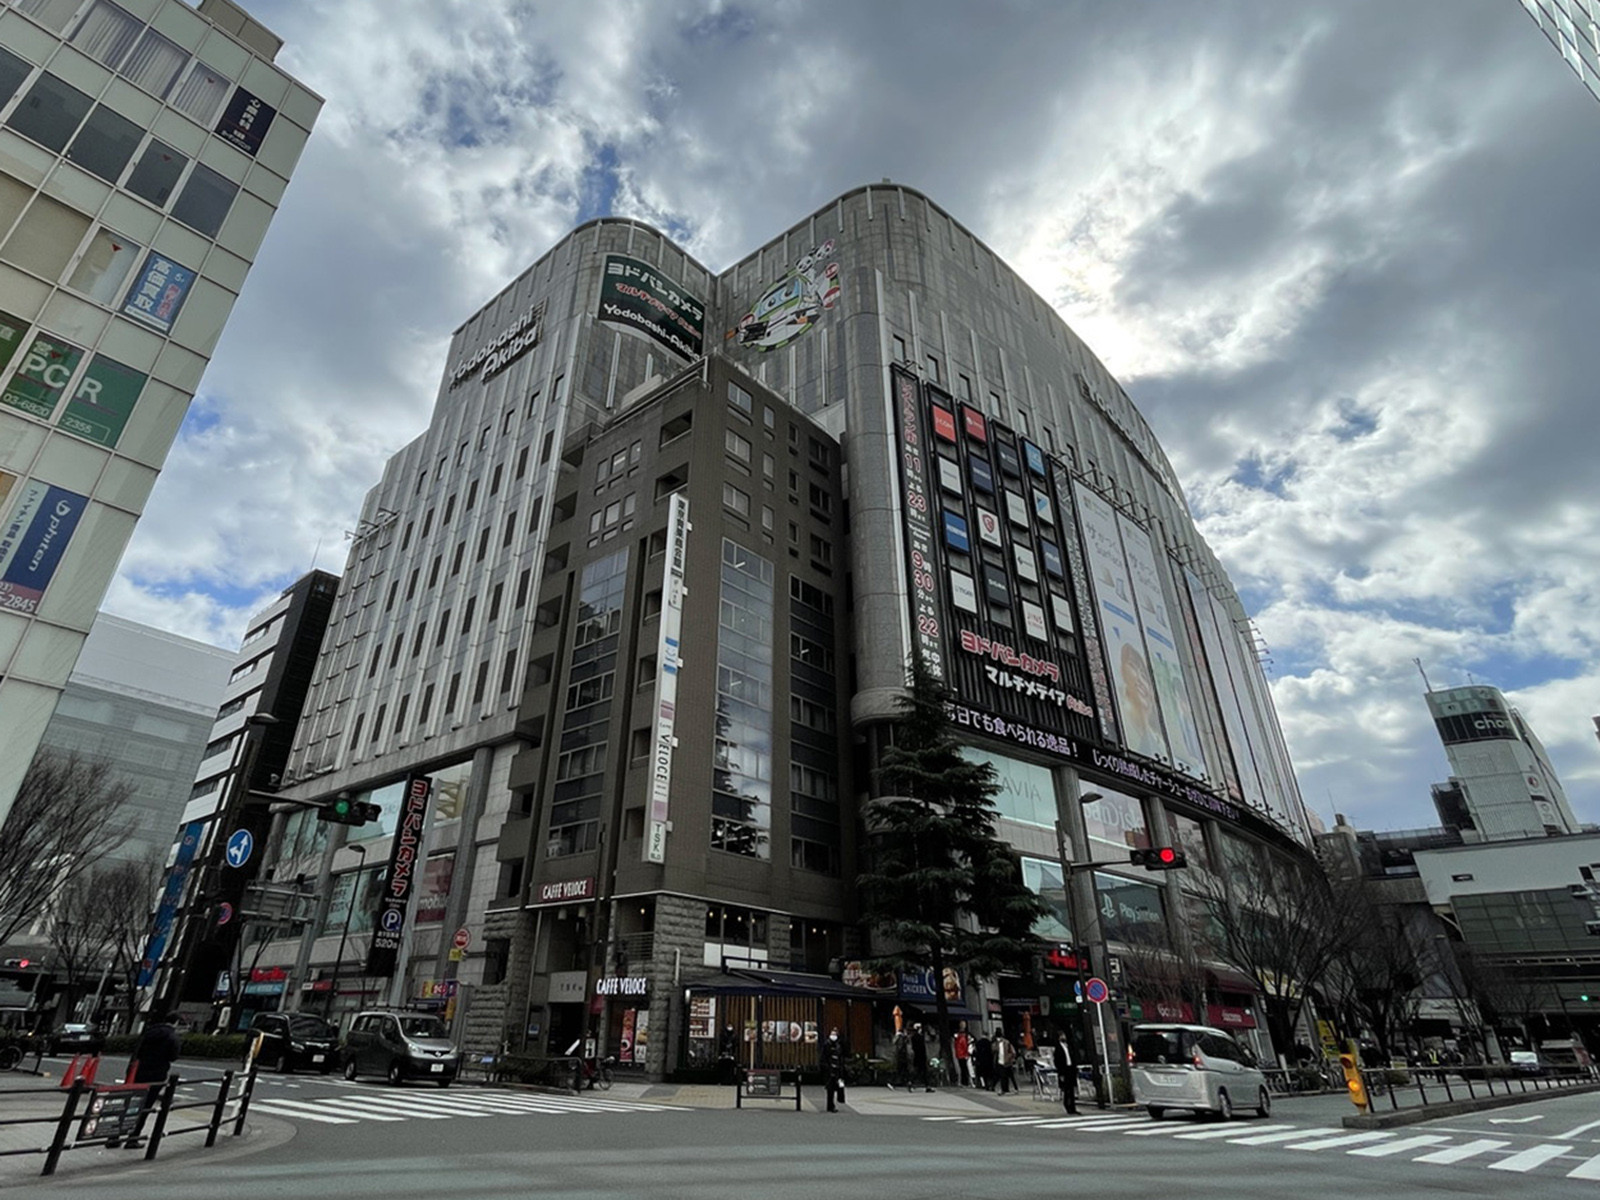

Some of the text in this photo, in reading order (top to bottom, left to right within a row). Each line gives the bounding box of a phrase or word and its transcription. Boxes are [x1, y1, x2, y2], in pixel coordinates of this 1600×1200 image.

[133, 257, 174, 311] 高価買取
[607, 261, 704, 322] ヨドバシカメラ
[449, 305, 537, 380] Yodobashi
[480, 329, 539, 382] Akiba
[18, 351, 104, 406] PCR
[28, 514, 62, 573] phiten
[917, 613, 939, 638] 22
[960, 629, 1060, 683] ヨドバシカメラ
[984, 663, 1066, 707] マルチメディア
[656, 733, 671, 782] VELOCE
[391, 779, 428, 897] ヨドバシカメラ
[563, 879, 587, 898] VELOCE
[619, 977, 647, 995] VELOCE
